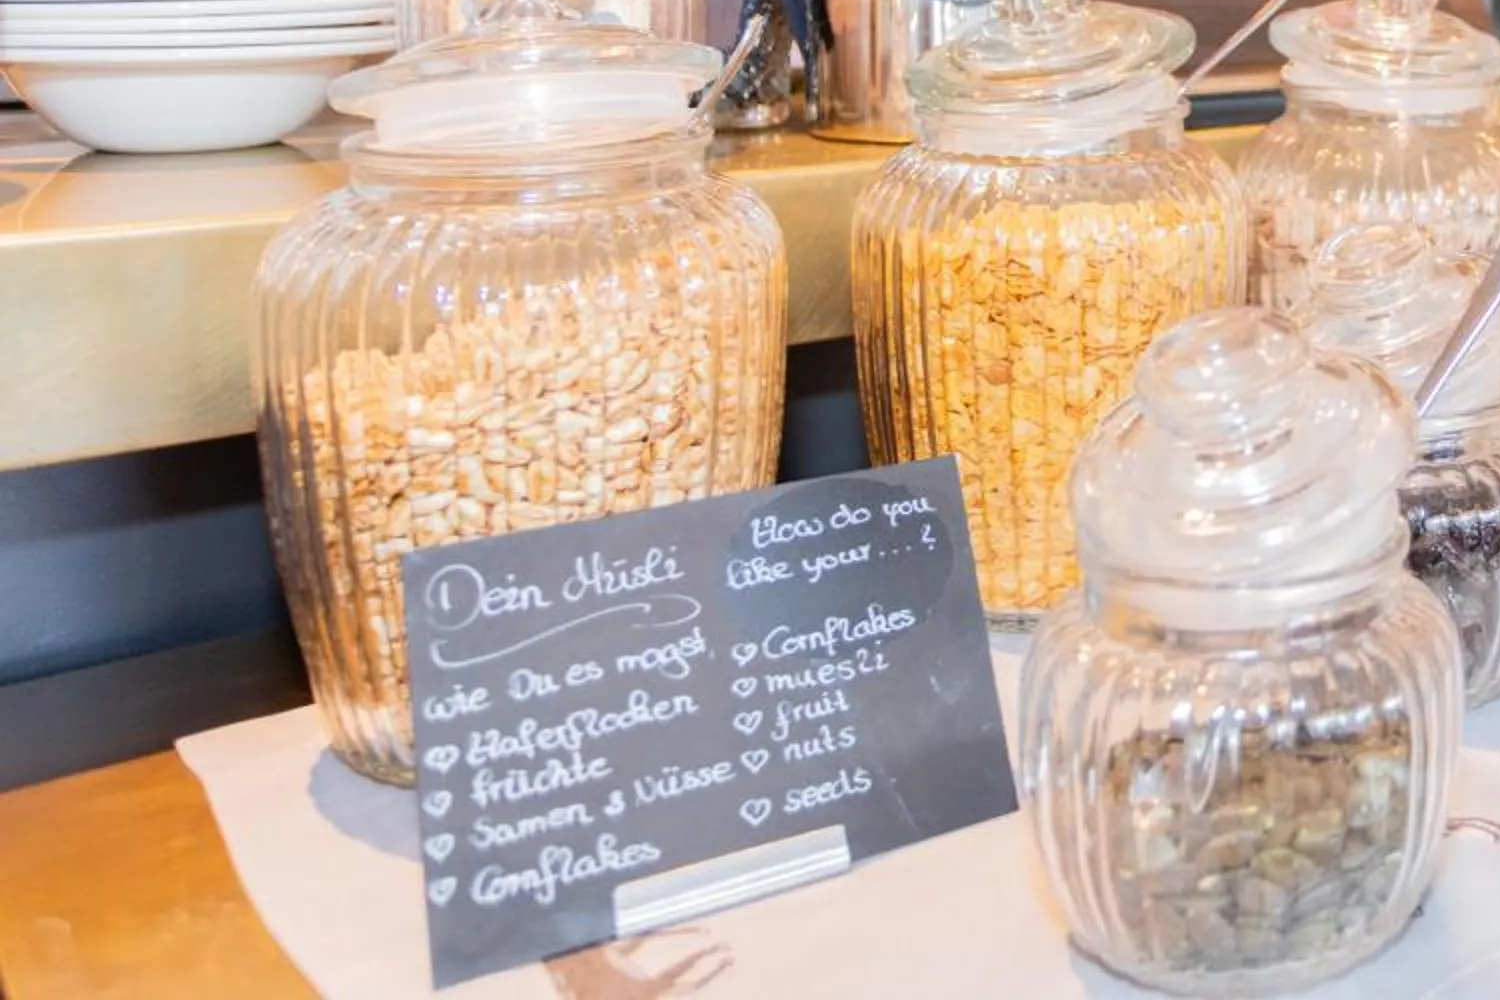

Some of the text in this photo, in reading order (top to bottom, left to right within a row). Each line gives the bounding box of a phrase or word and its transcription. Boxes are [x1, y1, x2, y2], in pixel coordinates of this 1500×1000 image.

[751, 497, 937, 548] How do you
[426, 545, 685, 631] Dein Müsli
[726, 556, 794, 590] like
[761, 602, 917, 659] Cornflakes
[423, 683, 491, 720] wie
[508, 668, 561, 699] Du
[565, 660, 604, 686] es
[764, 640, 890, 694] muesli
[466, 689, 699, 766] Haferflocken
[770, 689, 850, 742] fruit
[783, 724, 857, 763] nuts
[468, 815, 595, 850] Samen
[634, 761, 738, 805] Nüsse
[783, 767, 873, 815] seeds
[470, 832, 663, 903] Cornflakes
